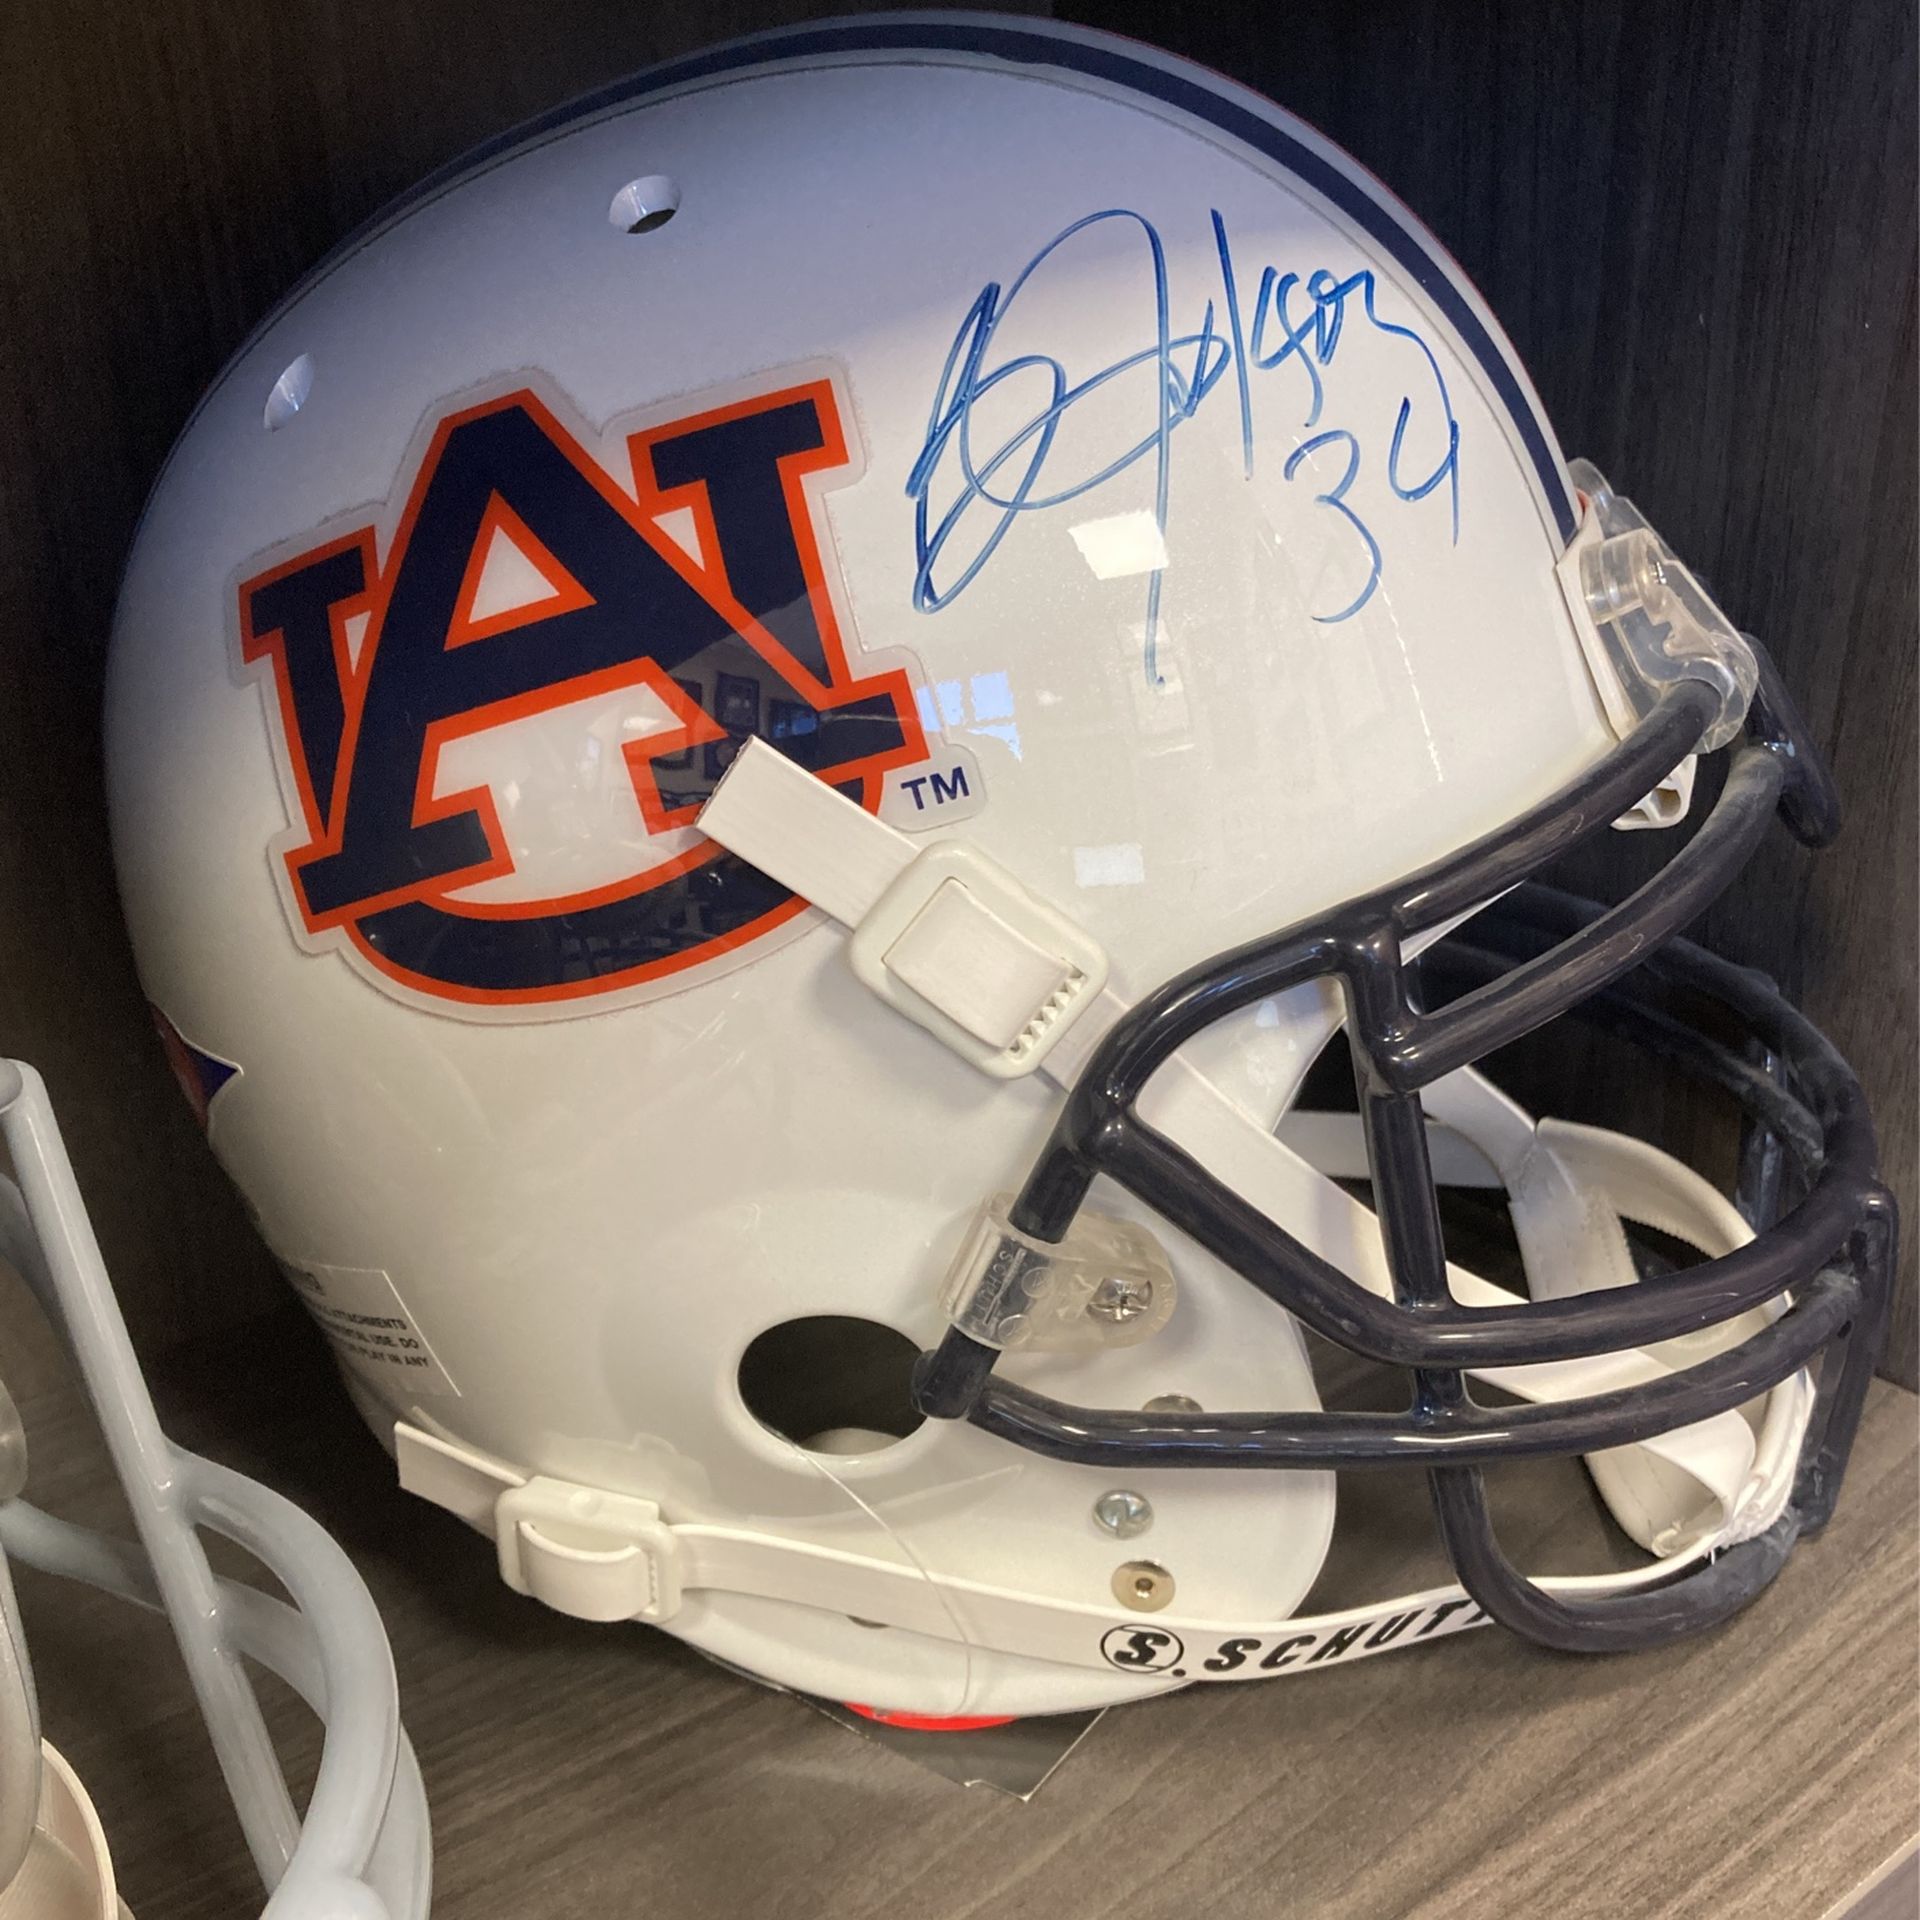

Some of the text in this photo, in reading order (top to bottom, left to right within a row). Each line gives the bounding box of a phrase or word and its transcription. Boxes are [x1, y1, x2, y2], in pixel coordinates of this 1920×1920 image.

[1284, 396, 1457, 624] 34
[900, 766, 970, 811] TM
[398, 1336, 419, 1349] DO
[1203, 1599, 1487, 1672] SCHUT
